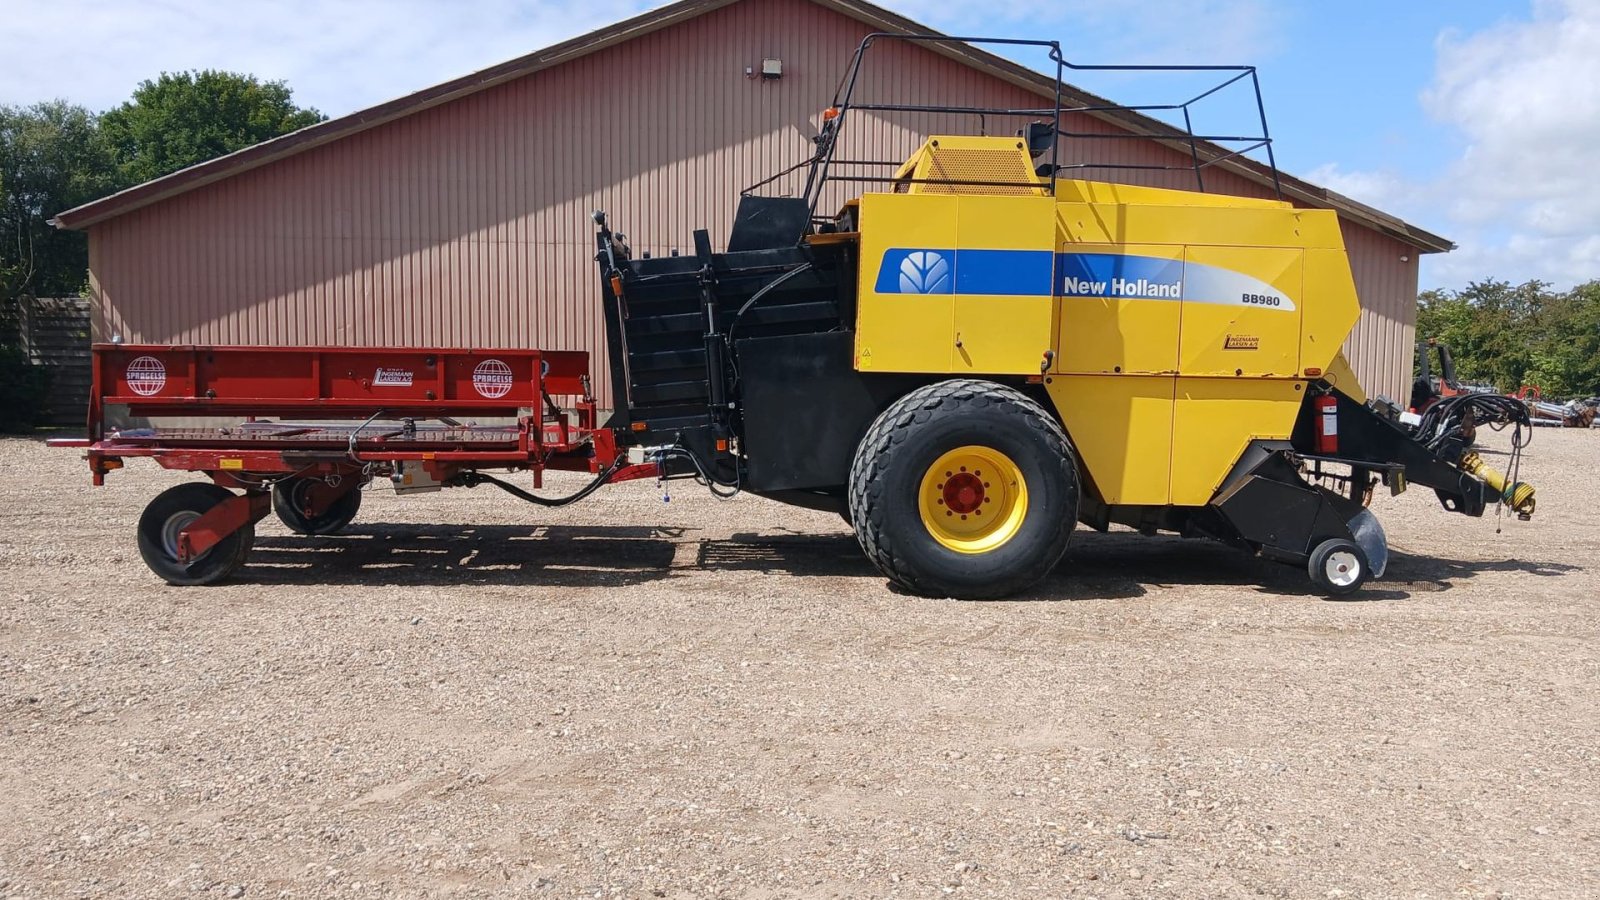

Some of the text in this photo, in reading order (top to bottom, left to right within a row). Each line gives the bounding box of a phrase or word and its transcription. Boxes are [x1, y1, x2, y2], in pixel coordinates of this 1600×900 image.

[1064, 276, 1181, 298] New Holland
[1242, 293, 1280, 306] BB980
